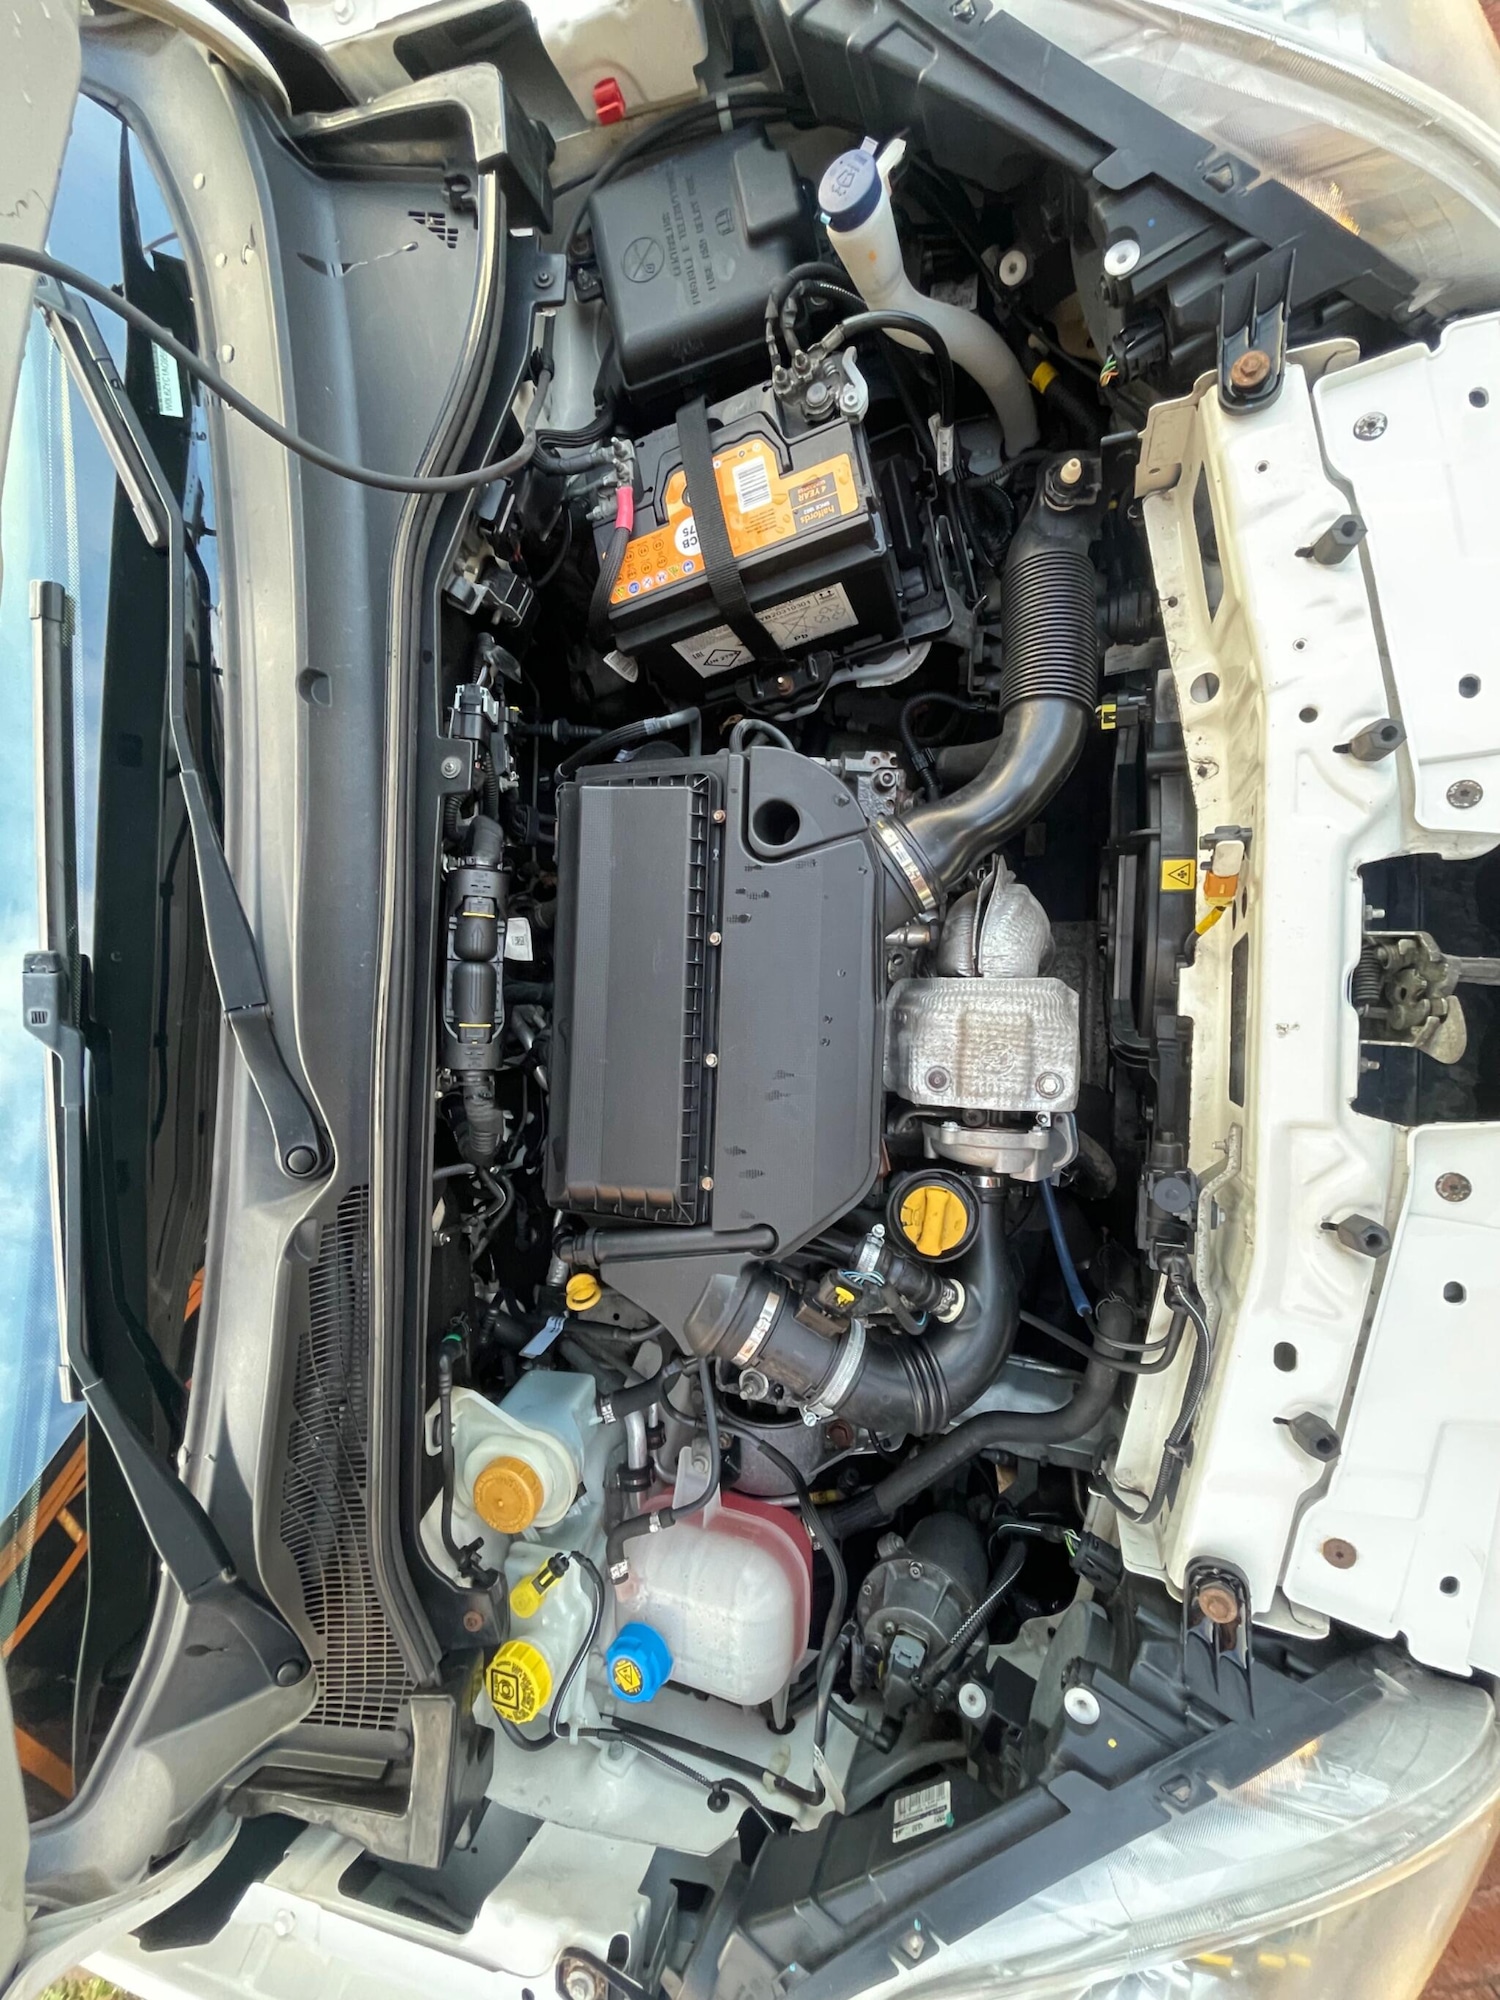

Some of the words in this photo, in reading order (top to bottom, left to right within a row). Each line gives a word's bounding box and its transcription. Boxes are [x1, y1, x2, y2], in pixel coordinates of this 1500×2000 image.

[821, 485, 827, 493] 4
[798, 488, 820, 502] YEAR
[800, 504, 835, 524] halfords
[793, 633, 809, 642] Pb
